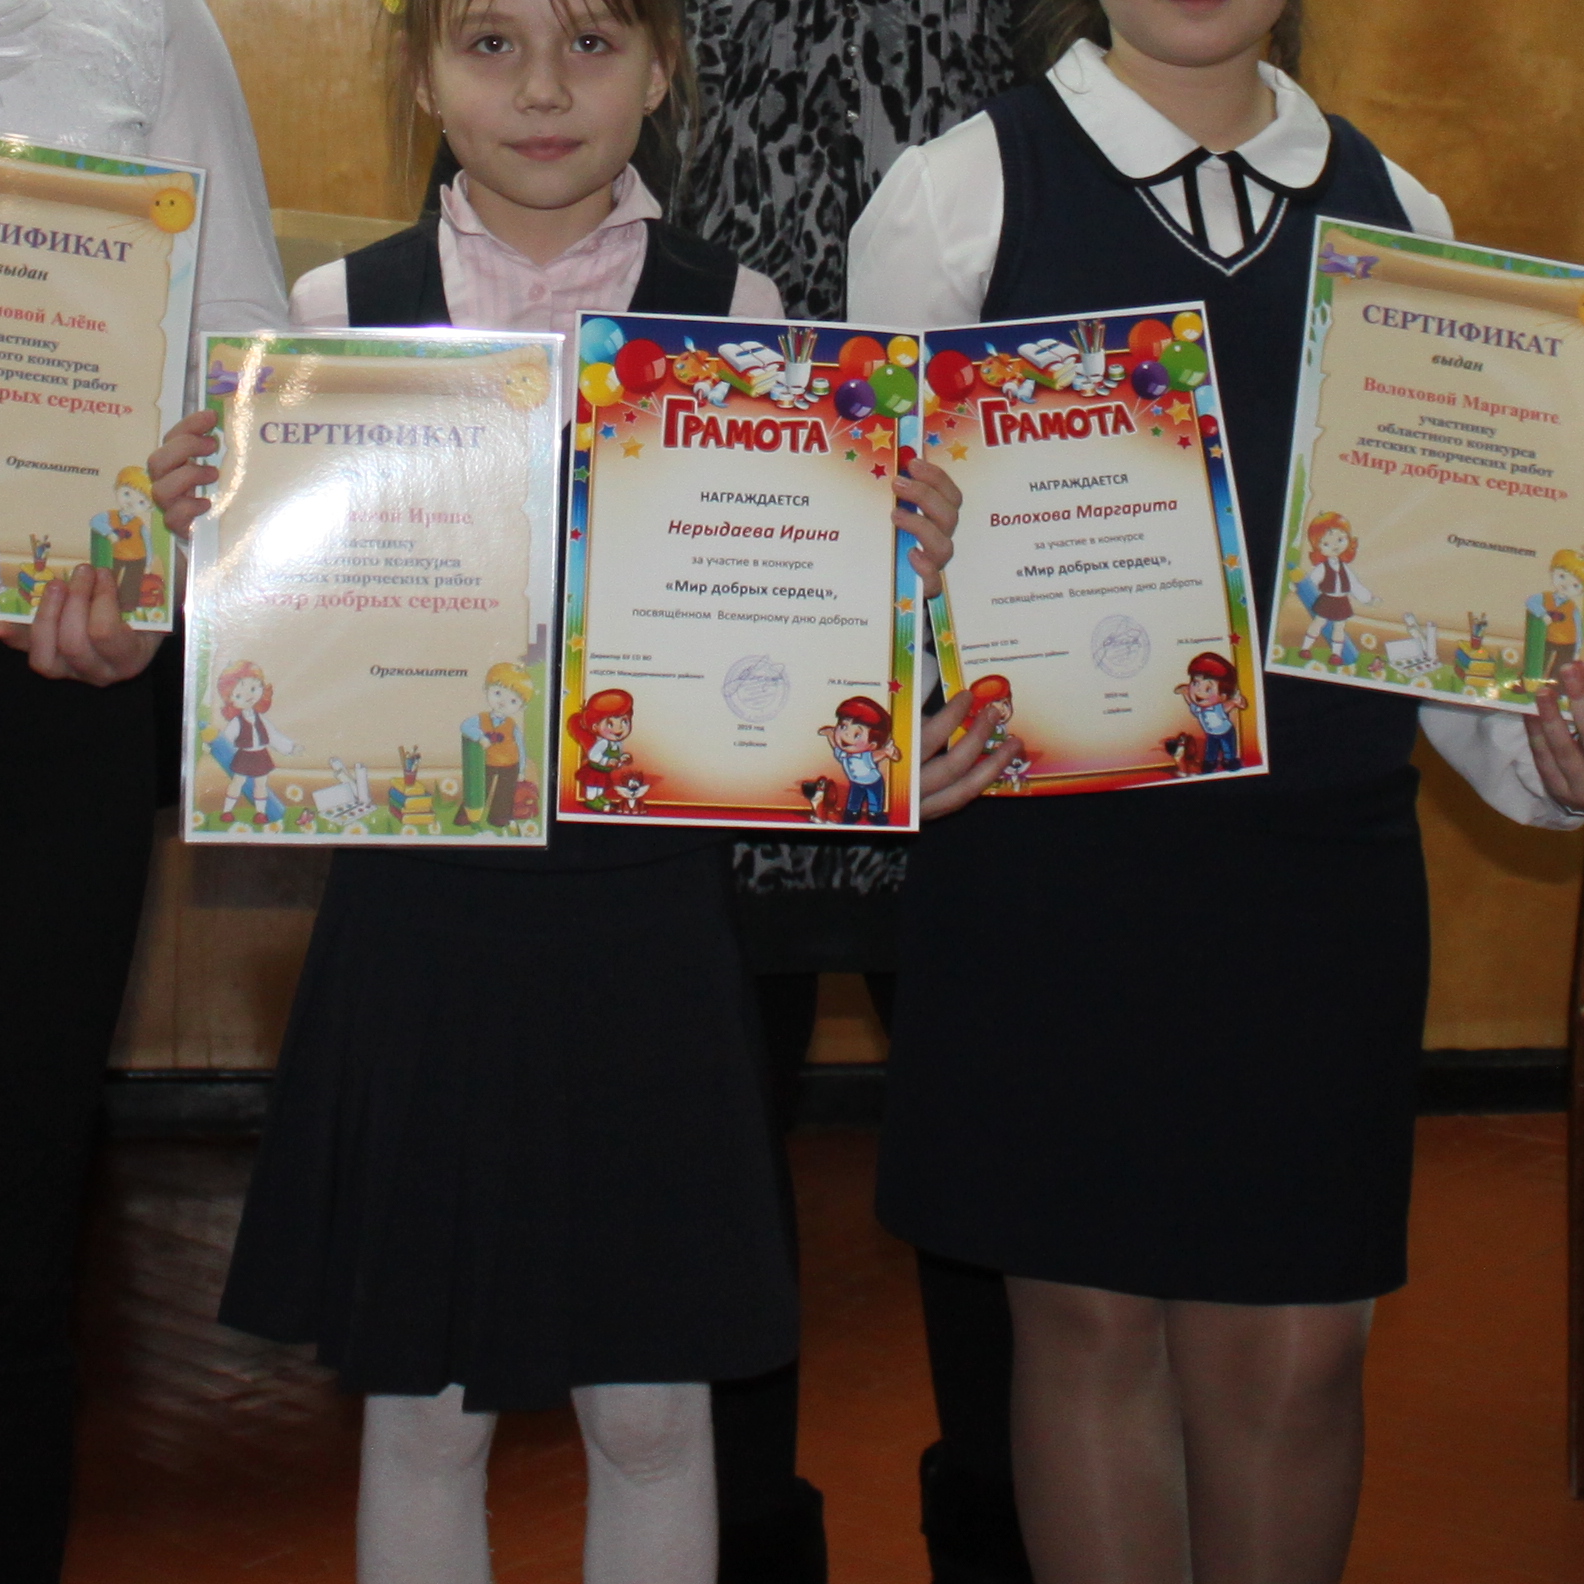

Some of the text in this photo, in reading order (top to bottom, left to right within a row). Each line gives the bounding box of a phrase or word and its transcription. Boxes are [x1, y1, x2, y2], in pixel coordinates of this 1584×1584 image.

[1363, 304, 1564, 357] СЕРТИФИКАТ
[27, 354, 100, 373] конкурса
[1432, 354, 1484, 372] выдан
[72, 377, 118, 392] работ
[1364, 376, 1457, 406] Волоховой
[48, 393, 133, 416] сердец»
[664, 396, 830, 453] ГРАМОТА
[978, 397, 1137, 447] ГРАМОТА
[1419, 414, 1497, 438] участнику
[260, 422, 486, 447] СЕРТИФИКАТ
[1378, 423, 1536, 459] областного конкурса
[6, 455, 99, 476] Оргкомитет
[1357, 436, 1554, 478] детских творческих работ
[1030, 474, 1129, 492] НАГРАЖДАЕТСЯ
[1338, 450, 1568, 502] «Мир добрых сердец»
[701, 492, 809, 506] НАГРАЖДАЕТСЯ
[990, 500, 1178, 527] Волохова Маргарита
[668, 520, 839, 544] Нерыдаева Ирина
[1034, 541, 1045, 549] за
[1049, 537, 1087, 549] участие
[1099, 532, 1144, 546] конкурсе
[1448, 534, 1536, 557] Оргкомитет
[692, 557, 703, 565] за
[706, 557, 749, 569] участие
[762, 560, 813, 572] конкурсе
[1016, 556, 1171, 578] «Мир добрых сердец»,
[334, 574, 429, 586] творческих
[435, 574, 483, 587] работ
[666, 580, 837, 600] «Мир добрых сердец»,
[992, 578, 1203, 605] посвящённом Всемирному дню доброты
[314, 590, 401, 611] добрых
[409, 594, 499, 613] сердец»
[632, 608, 868, 626] посвящённом Всемирному дню доброты
[370, 665, 468, 678] Оргкомитет
